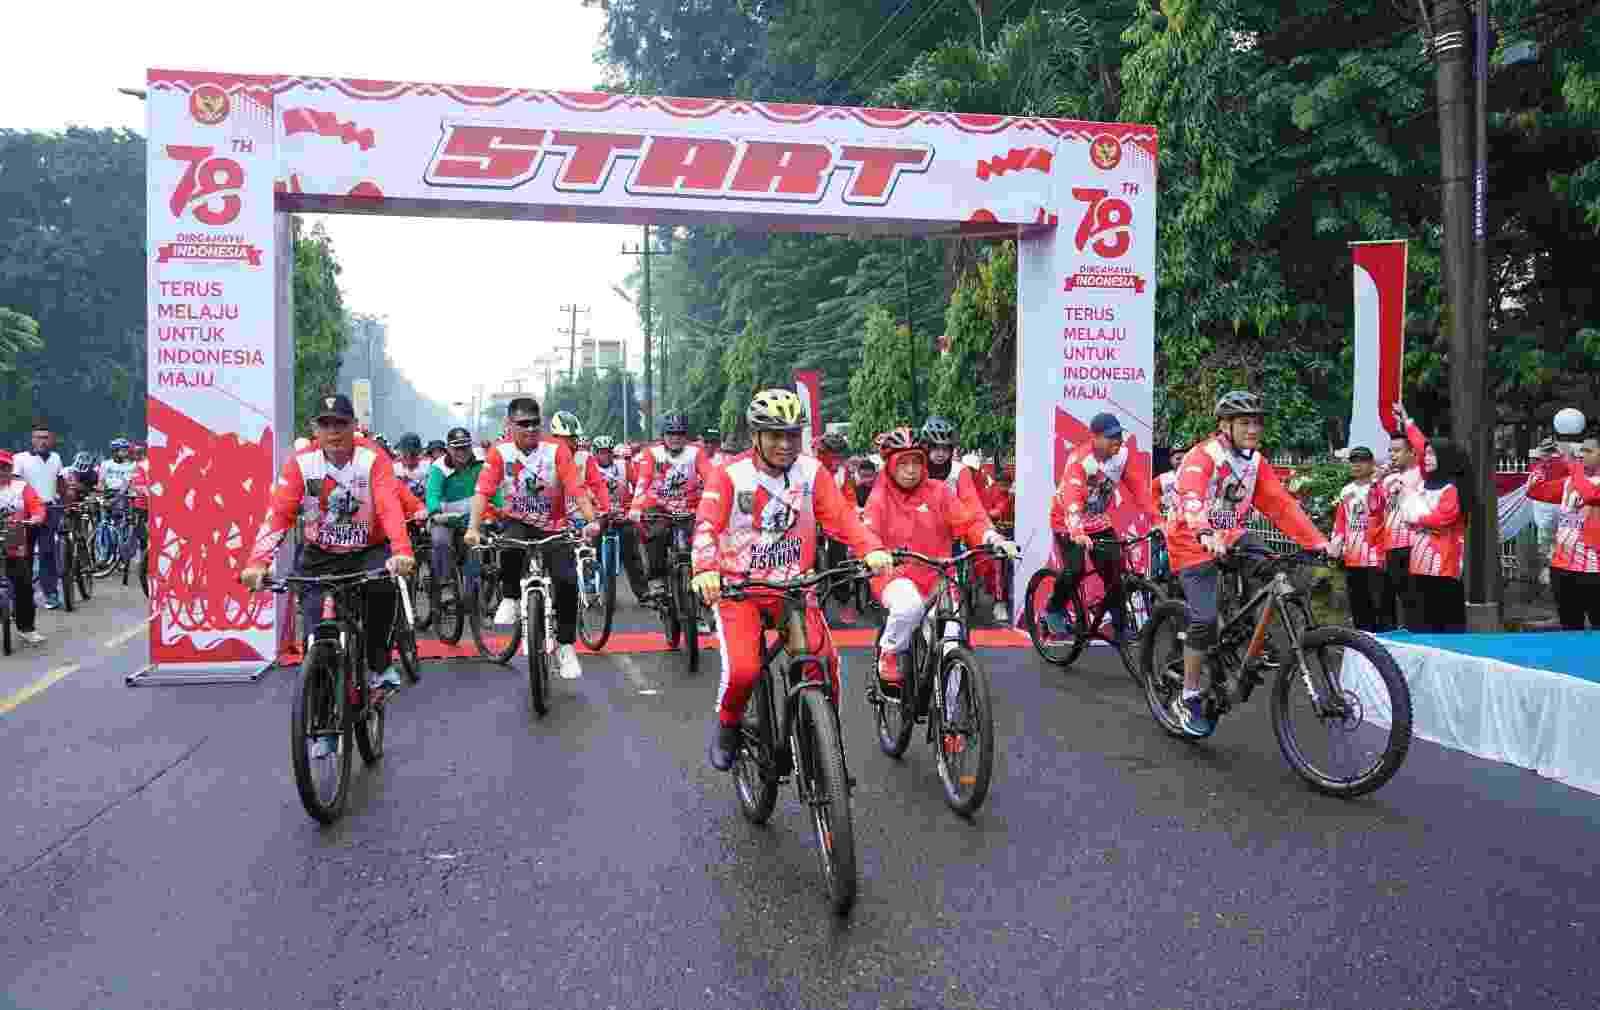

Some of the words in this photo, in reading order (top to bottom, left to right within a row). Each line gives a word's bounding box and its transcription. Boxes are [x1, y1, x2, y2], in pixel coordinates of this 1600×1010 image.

[425, 122, 934, 205] START
[166, 144, 244, 225] 78
[1072, 187, 1133, 257] 78
[175, 244, 248, 257] INDONESIA
[159, 280, 223, 297] TERUS
[1075, 275, 1136, 287] INDONESIA
[158, 303, 239, 321] MELAJU
[1064, 306, 1114, 321] TERUS
[158, 326, 224, 342] UNTUK
[1064, 326, 1127, 341] MELAJU
[158, 348, 264, 366] INDONESIA
[1064, 345, 1119, 361] UNTUK
[158, 370, 214, 387] MAJU
[1064, 366, 1146, 382] INDONESIA
[1063, 383, 1107, 400] MAJU
